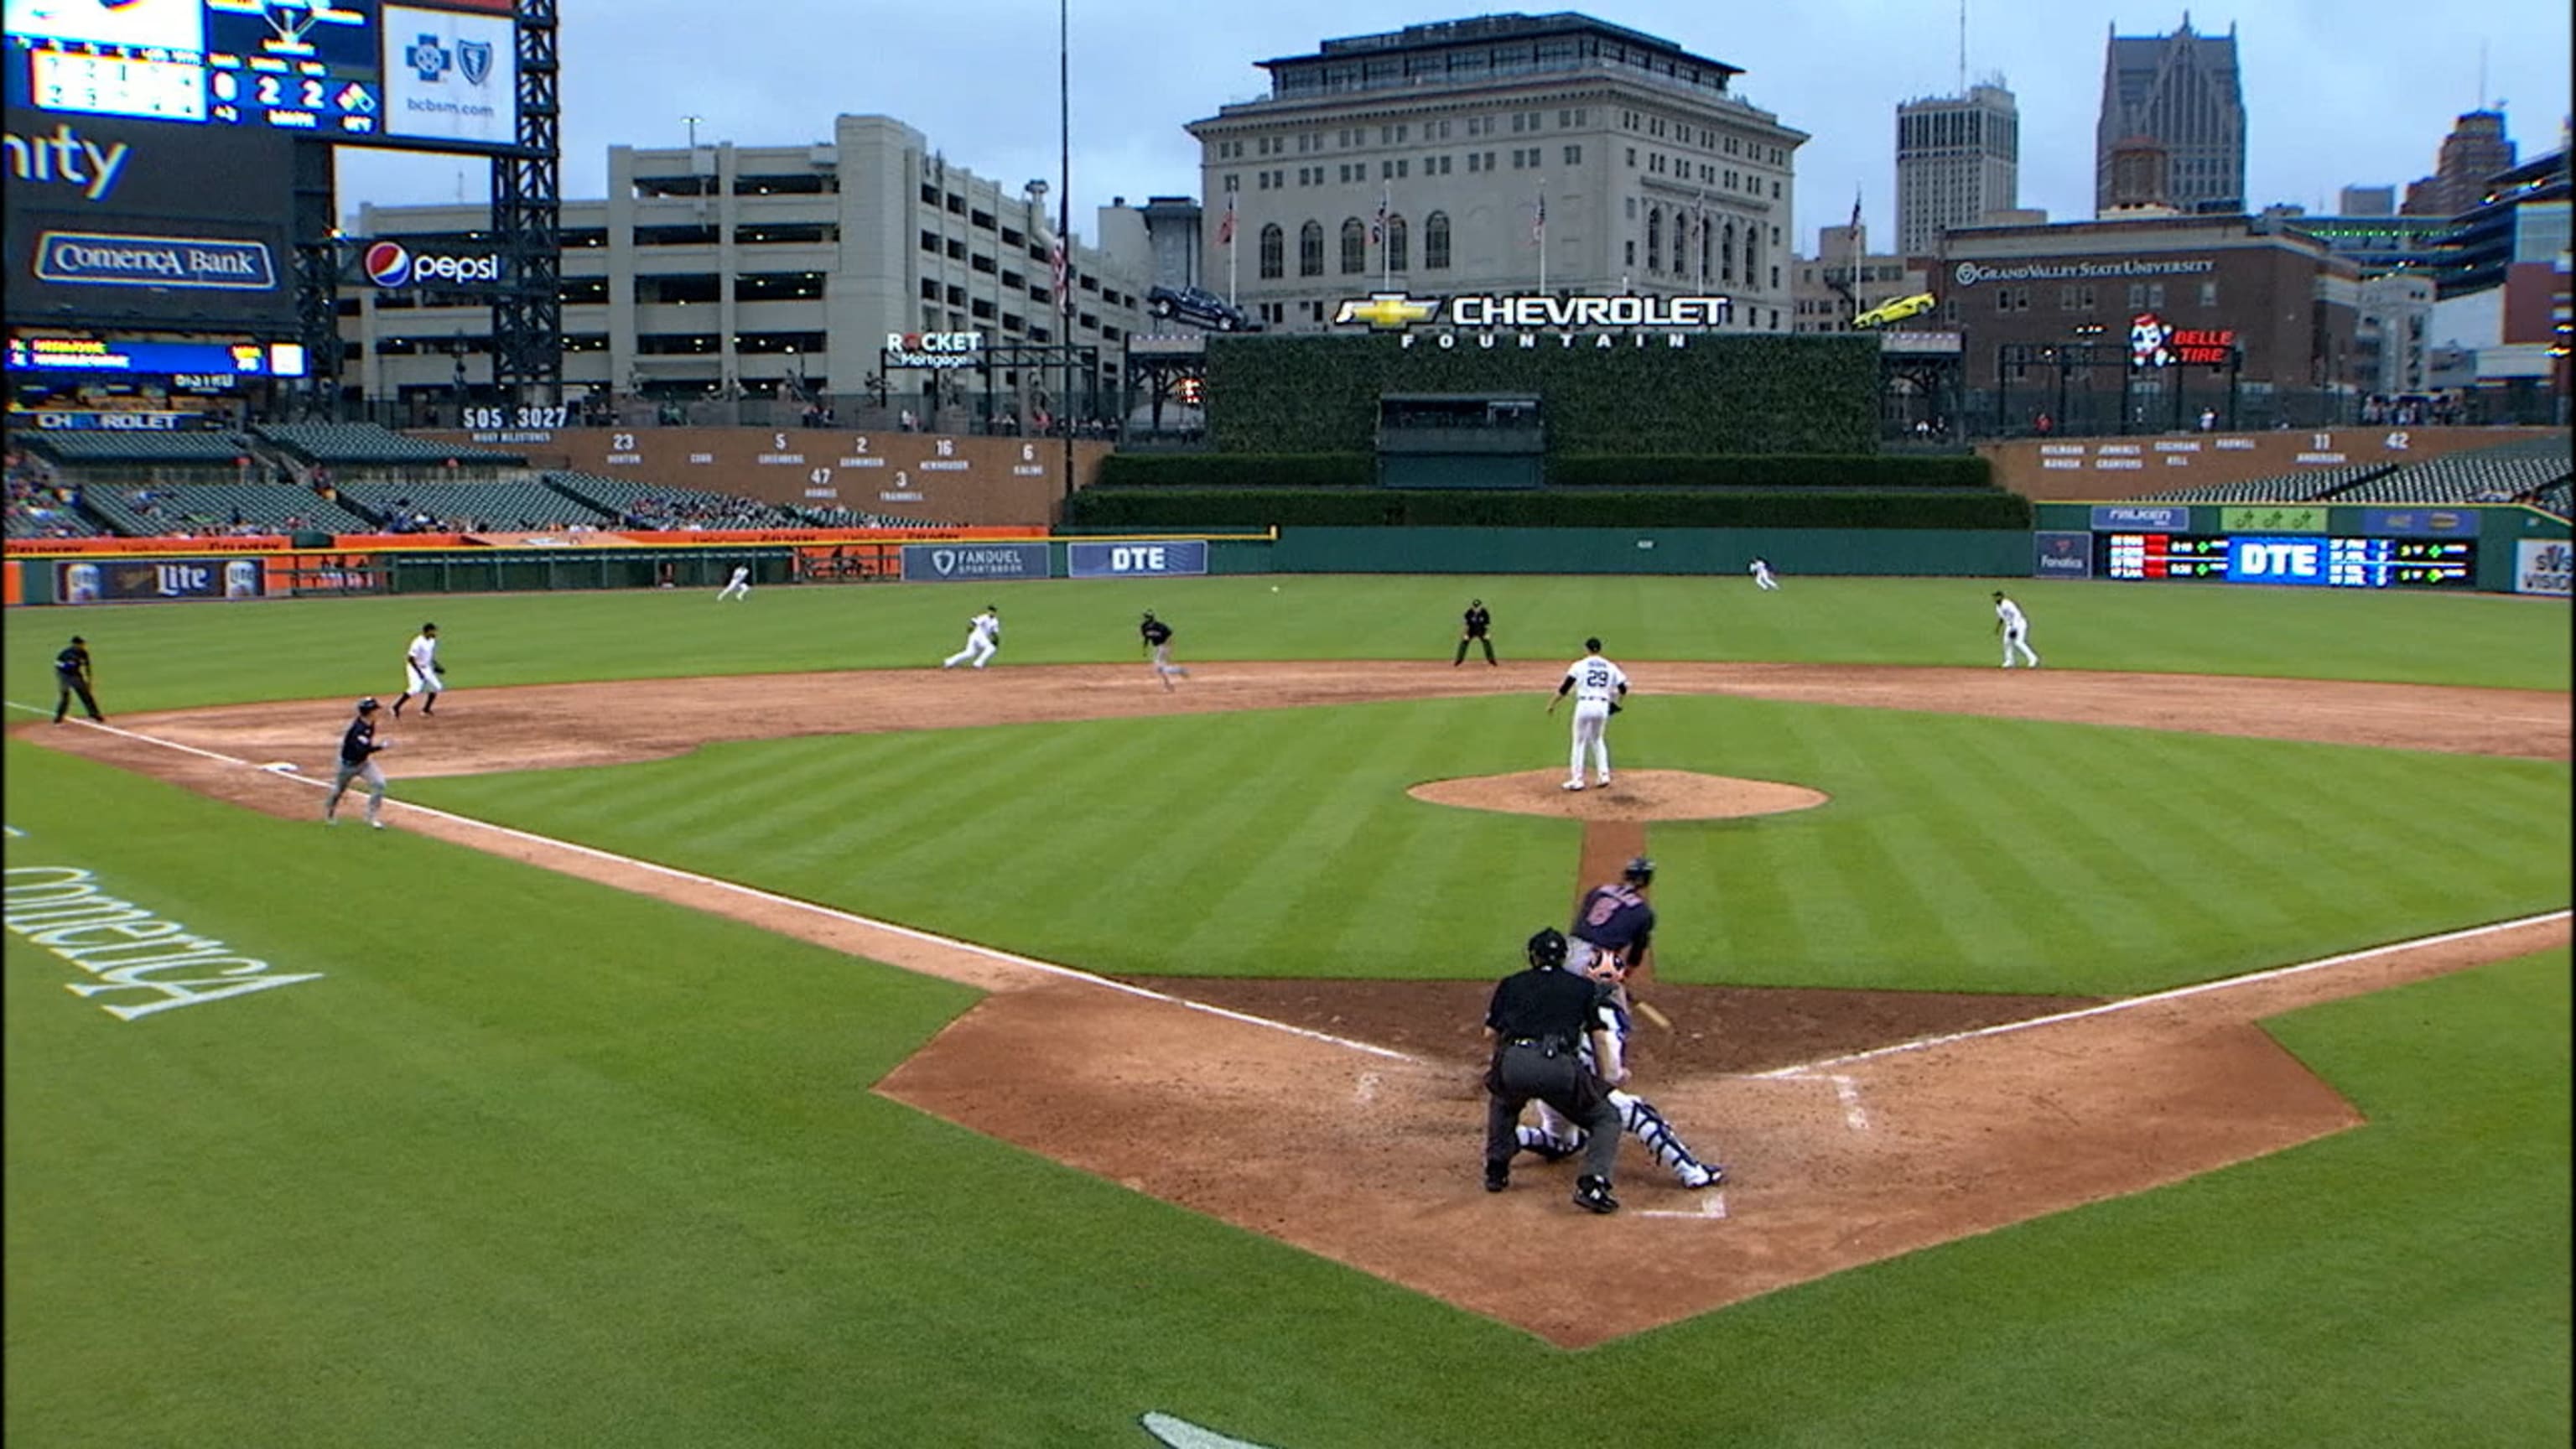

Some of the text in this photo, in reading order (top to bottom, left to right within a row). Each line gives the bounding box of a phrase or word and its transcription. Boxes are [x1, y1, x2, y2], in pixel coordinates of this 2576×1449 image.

[258, 76, 281, 106] 2
[302, 80, 325, 110] 2
[407, 96, 495, 117] bcbsm.com
[190, 250, 256, 274] Bank
[414, 253, 498, 283] pepsi
[1452, 297, 1728, 326] CHEVROLET
[887, 332, 982, 351] ROCKET
[1401, 334, 1686, 349] FOUNTAIN
[2174, 331, 2234, 345] BELLE
[901, 353, 968, 368] Mortgage
[2180, 348, 2226, 362] TIRE
[463, 407, 503, 428] 505
[613, 434, 635, 450] 23
[776, 433, 787, 450] 5
[857, 436, 868, 453] 2
[937, 439, 953, 456] 16
[2385, 432, 2410, 450] 42
[1023, 444, 1034, 460] 6
[810, 467, 831, 484] 47
[895, 470, 907, 488] 3
[958, 551, 1022, 564] FANDUEL
[1112, 548, 1165, 570] DTE
[2241, 543, 2317, 576] DTE
[156, 564, 209, 595] Lite
[1587, 670, 1608, 688] 29
